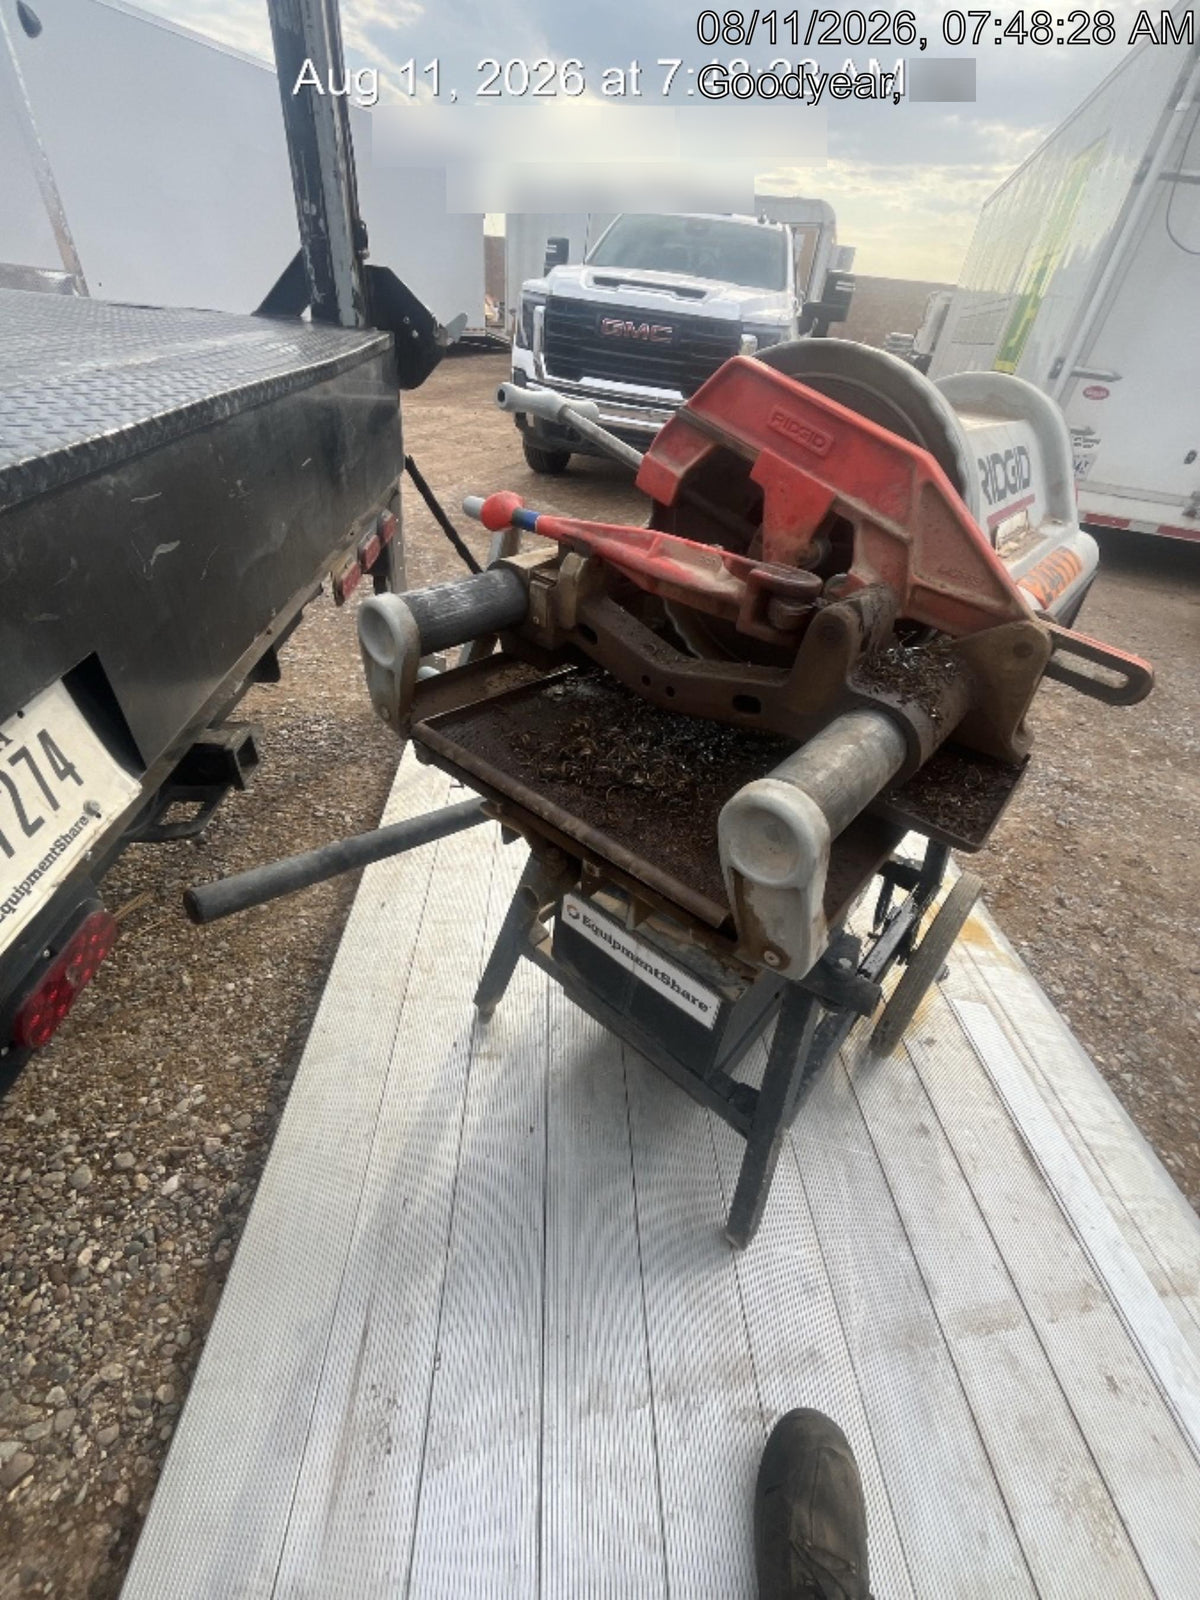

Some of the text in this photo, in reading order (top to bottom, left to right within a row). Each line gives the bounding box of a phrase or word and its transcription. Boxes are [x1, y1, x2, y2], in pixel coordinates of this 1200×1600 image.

[602, 317, 673, 343] GMC
[770, 410, 827, 449] RIDGID
[977, 445, 1031, 506] RIDGID
[0, 729, 84, 860] 274
[581, 914, 711, 1013] EquipmentShare
